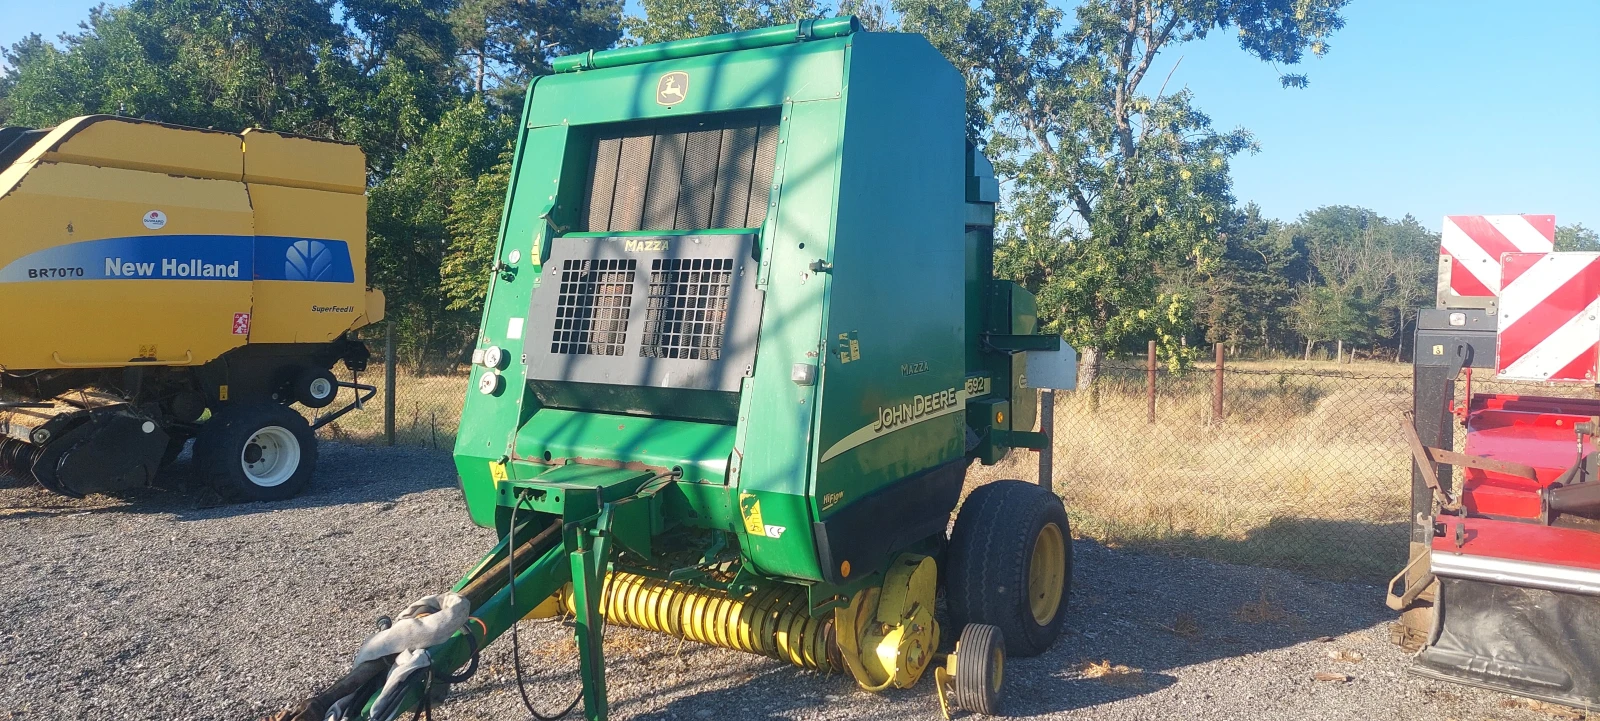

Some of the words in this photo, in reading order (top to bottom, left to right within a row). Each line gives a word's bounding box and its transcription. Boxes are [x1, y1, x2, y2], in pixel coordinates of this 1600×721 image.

[624, 239, 670, 252] MAZZA
[28, 267, 84, 279] BR7070
[105, 257, 155, 277] New
[162, 258, 240, 278] Holland
[311, 304, 349, 313] SuperFeed
[901, 360, 930, 376] MAZZA
[967, 377, 985, 394] 592
[874, 403, 914, 432] JOHN
[913, 387, 957, 418] DEERE
